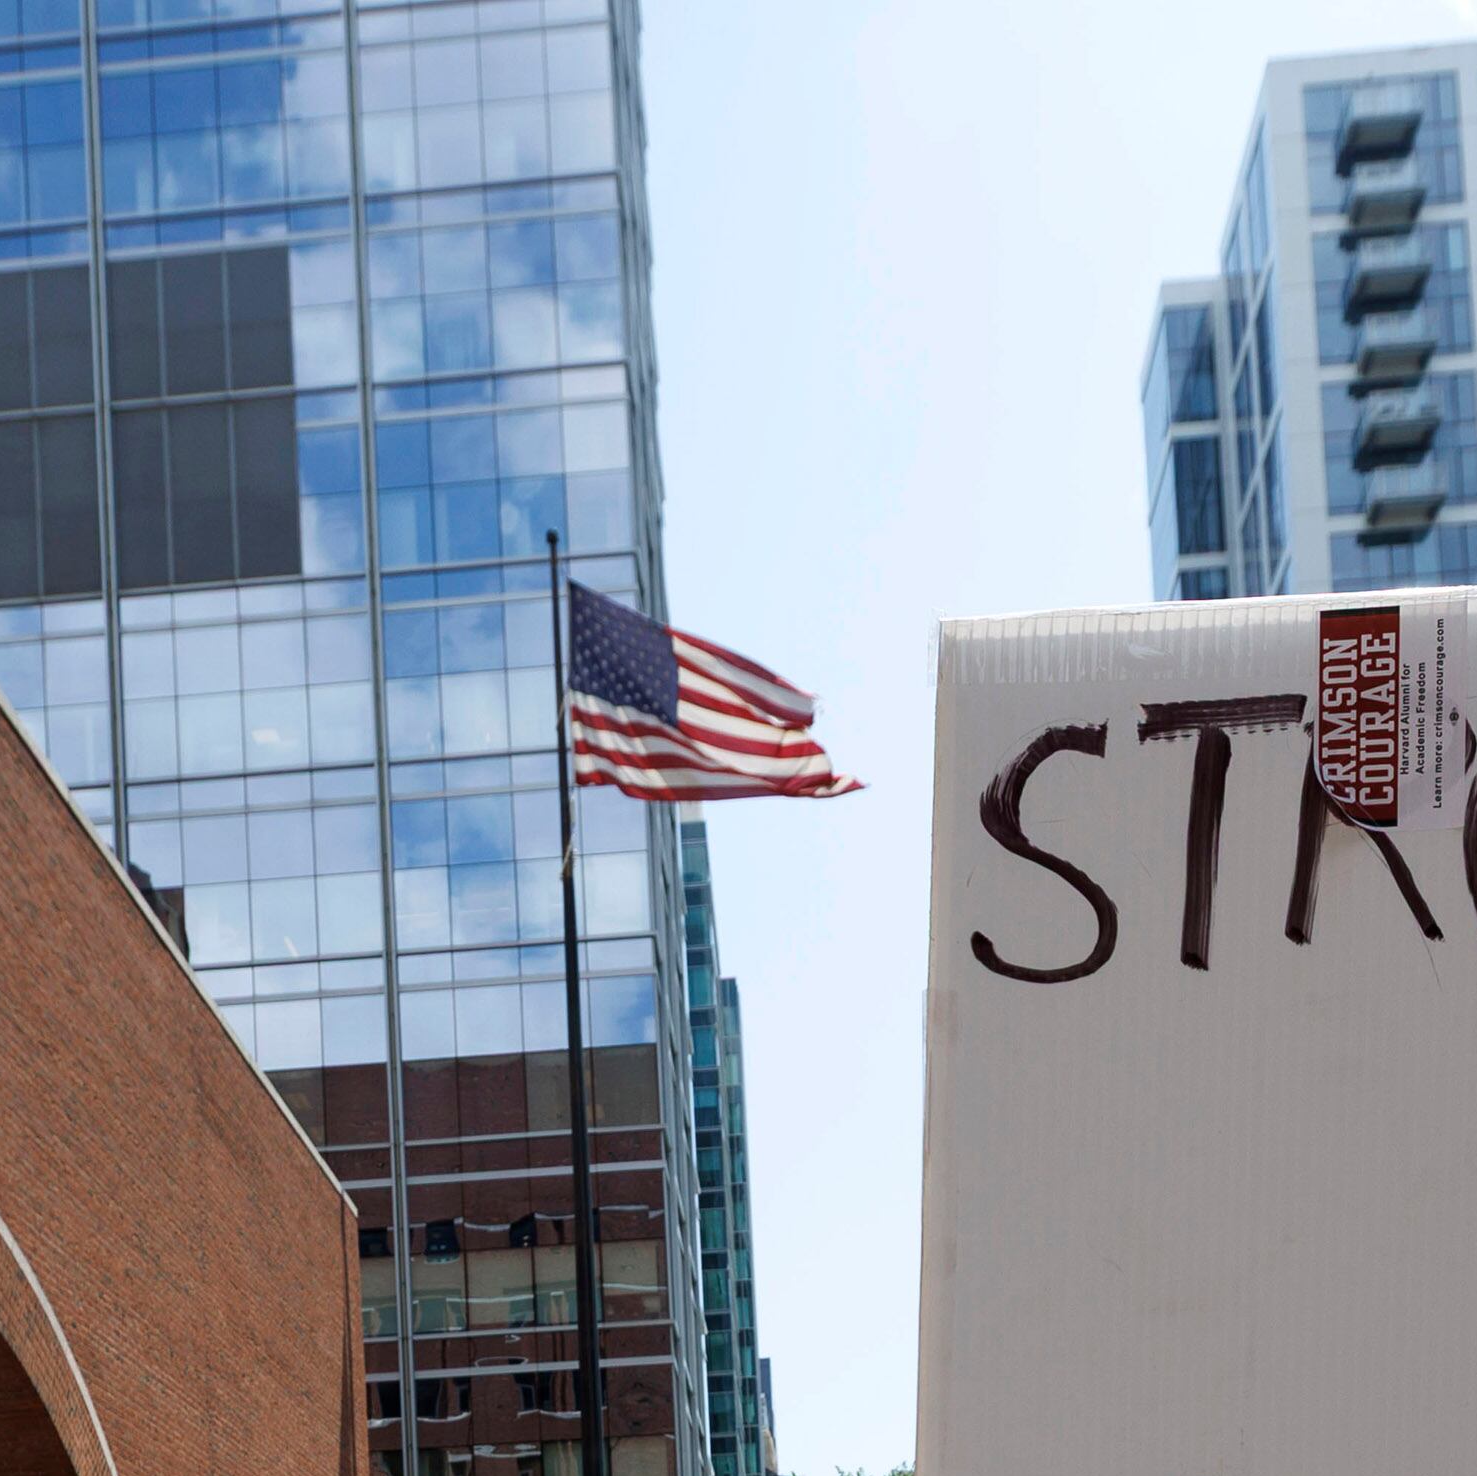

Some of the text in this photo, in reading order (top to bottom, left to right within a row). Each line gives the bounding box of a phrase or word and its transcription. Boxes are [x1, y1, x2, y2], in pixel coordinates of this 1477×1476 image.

[1321, 637, 1359, 804] CRIMSON
[1359, 631, 1397, 806] COURAGE
[1400, 663, 1411, 775] Harvard Alumni for
[1416, 661, 1426, 775] Academic Freedom
[1433, 617, 1446, 809] Learn more: crimsoncourage.com
